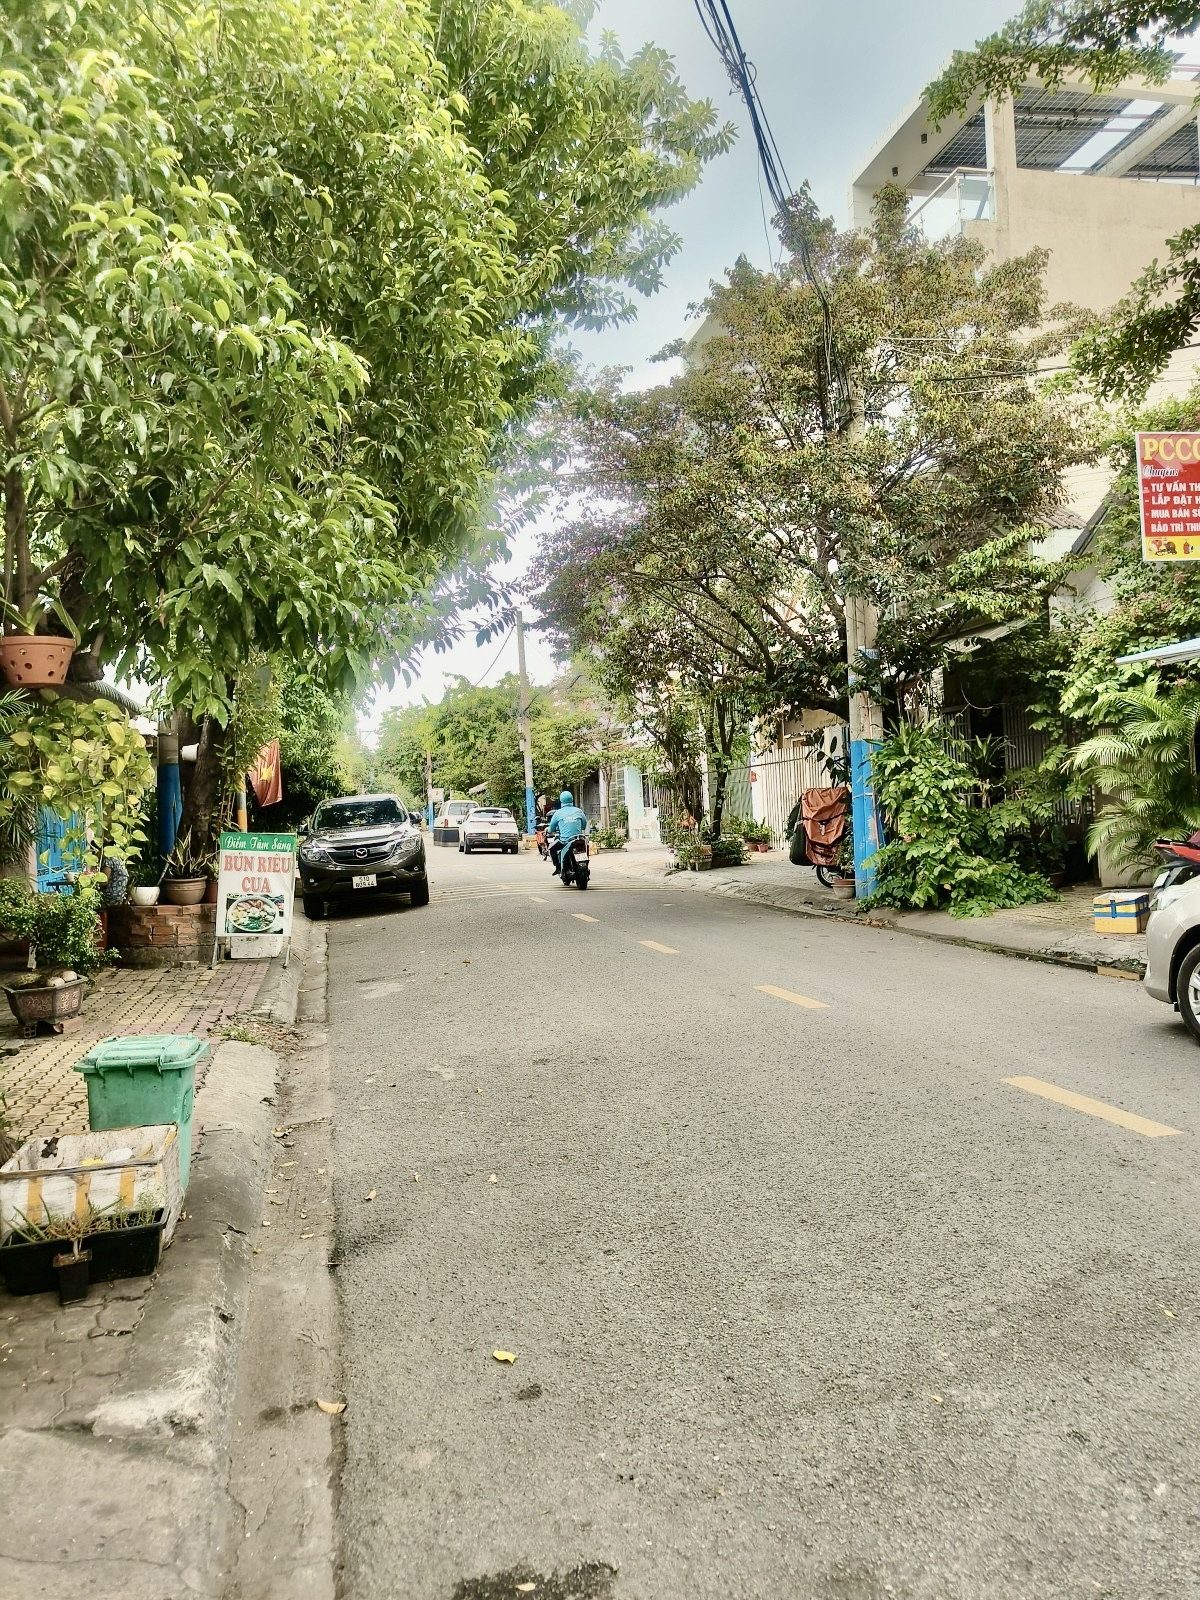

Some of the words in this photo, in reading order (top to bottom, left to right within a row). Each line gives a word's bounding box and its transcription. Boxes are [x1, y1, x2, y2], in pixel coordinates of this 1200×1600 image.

[1151, 482, 1165, 492] TƯ
[1166, 480, 1186, 492] VẤN
[1152, 493, 1170, 505] LẮP
[1173, 494, 1192, 506] ĐẶT
[1151, 509, 1170, 518] MUA
[1172, 507, 1190, 518] BÁN
[1151, 521, 1168, 532] BẢO
[1170, 521, 1184, 532] TRÌ
[225, 836, 246, 849] Điểm
[250, 836, 269, 850] Tâm
[271, 838, 292, 852] Sáng
[223, 852, 254, 872] BÚN
[257, 853, 292, 873] RIÊU
[241, 876, 272, 893] CUA
